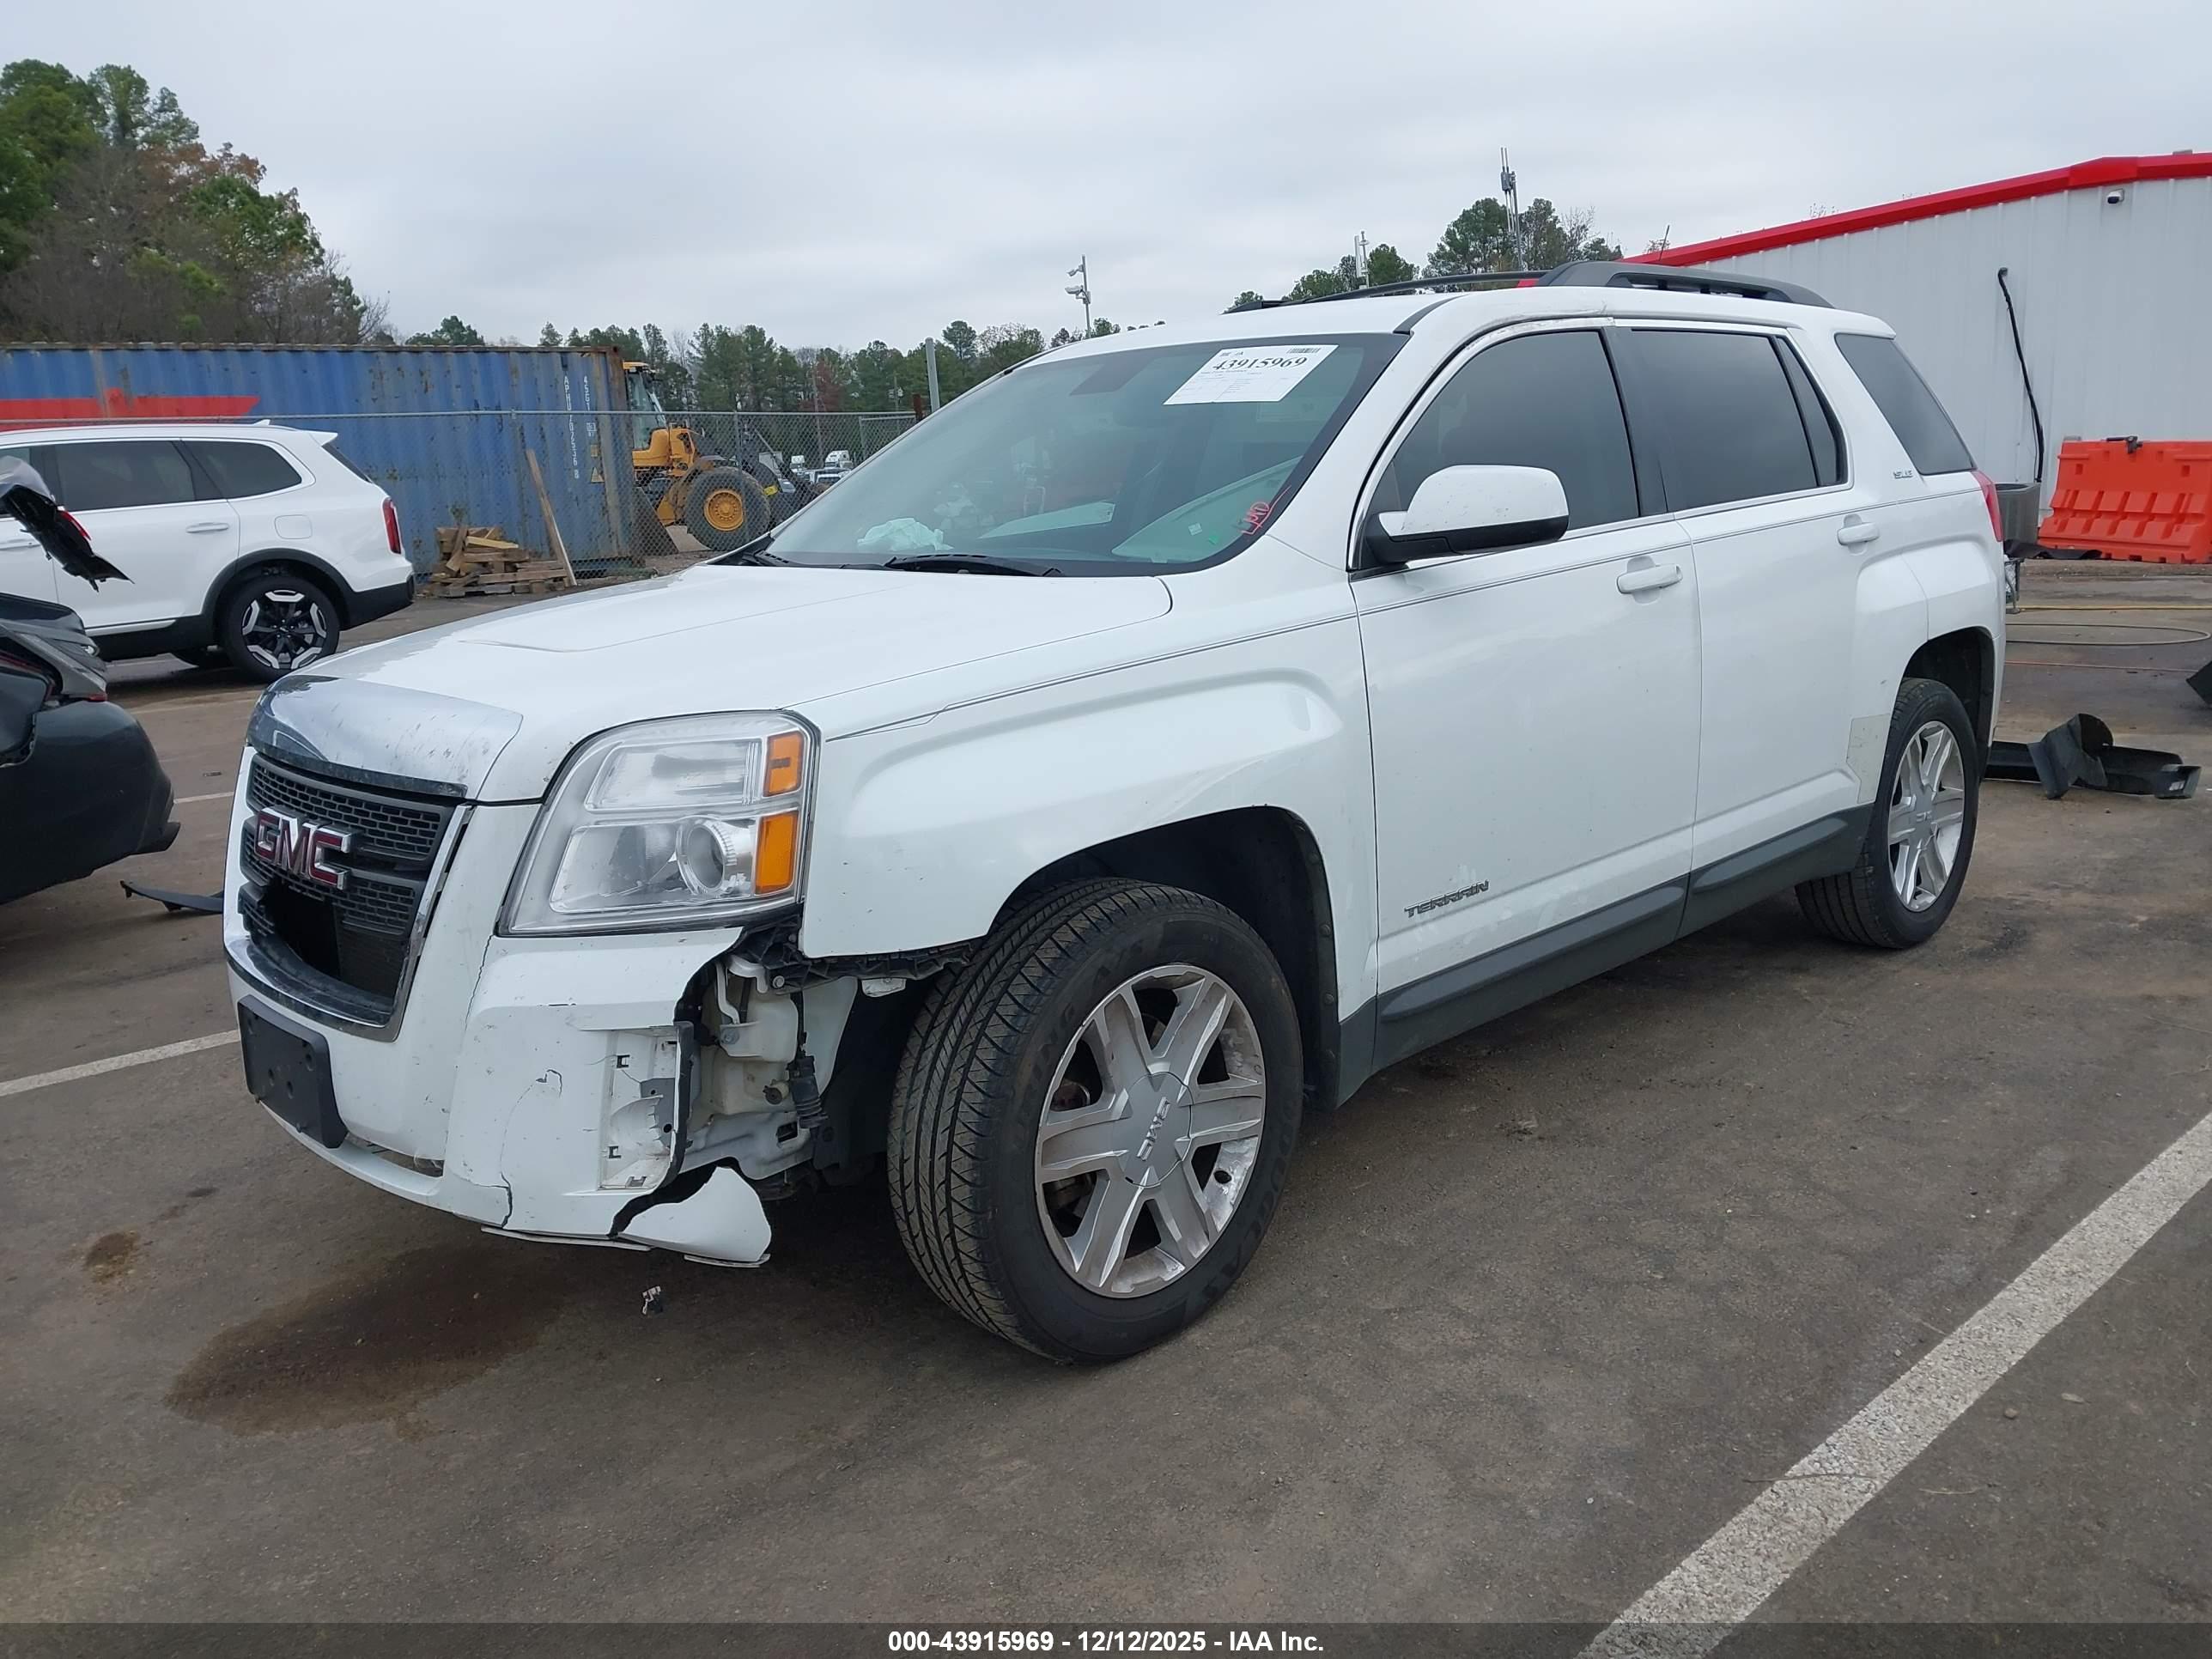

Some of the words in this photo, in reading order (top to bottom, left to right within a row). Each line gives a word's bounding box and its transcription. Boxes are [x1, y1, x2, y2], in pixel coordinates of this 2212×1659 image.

[1212, 356, 1308, 371] 43915969
[253, 807, 352, 890] GMC
[1403, 879, 1489, 919] TERRAIN
[1136, 1096, 1171, 1162] GMC
